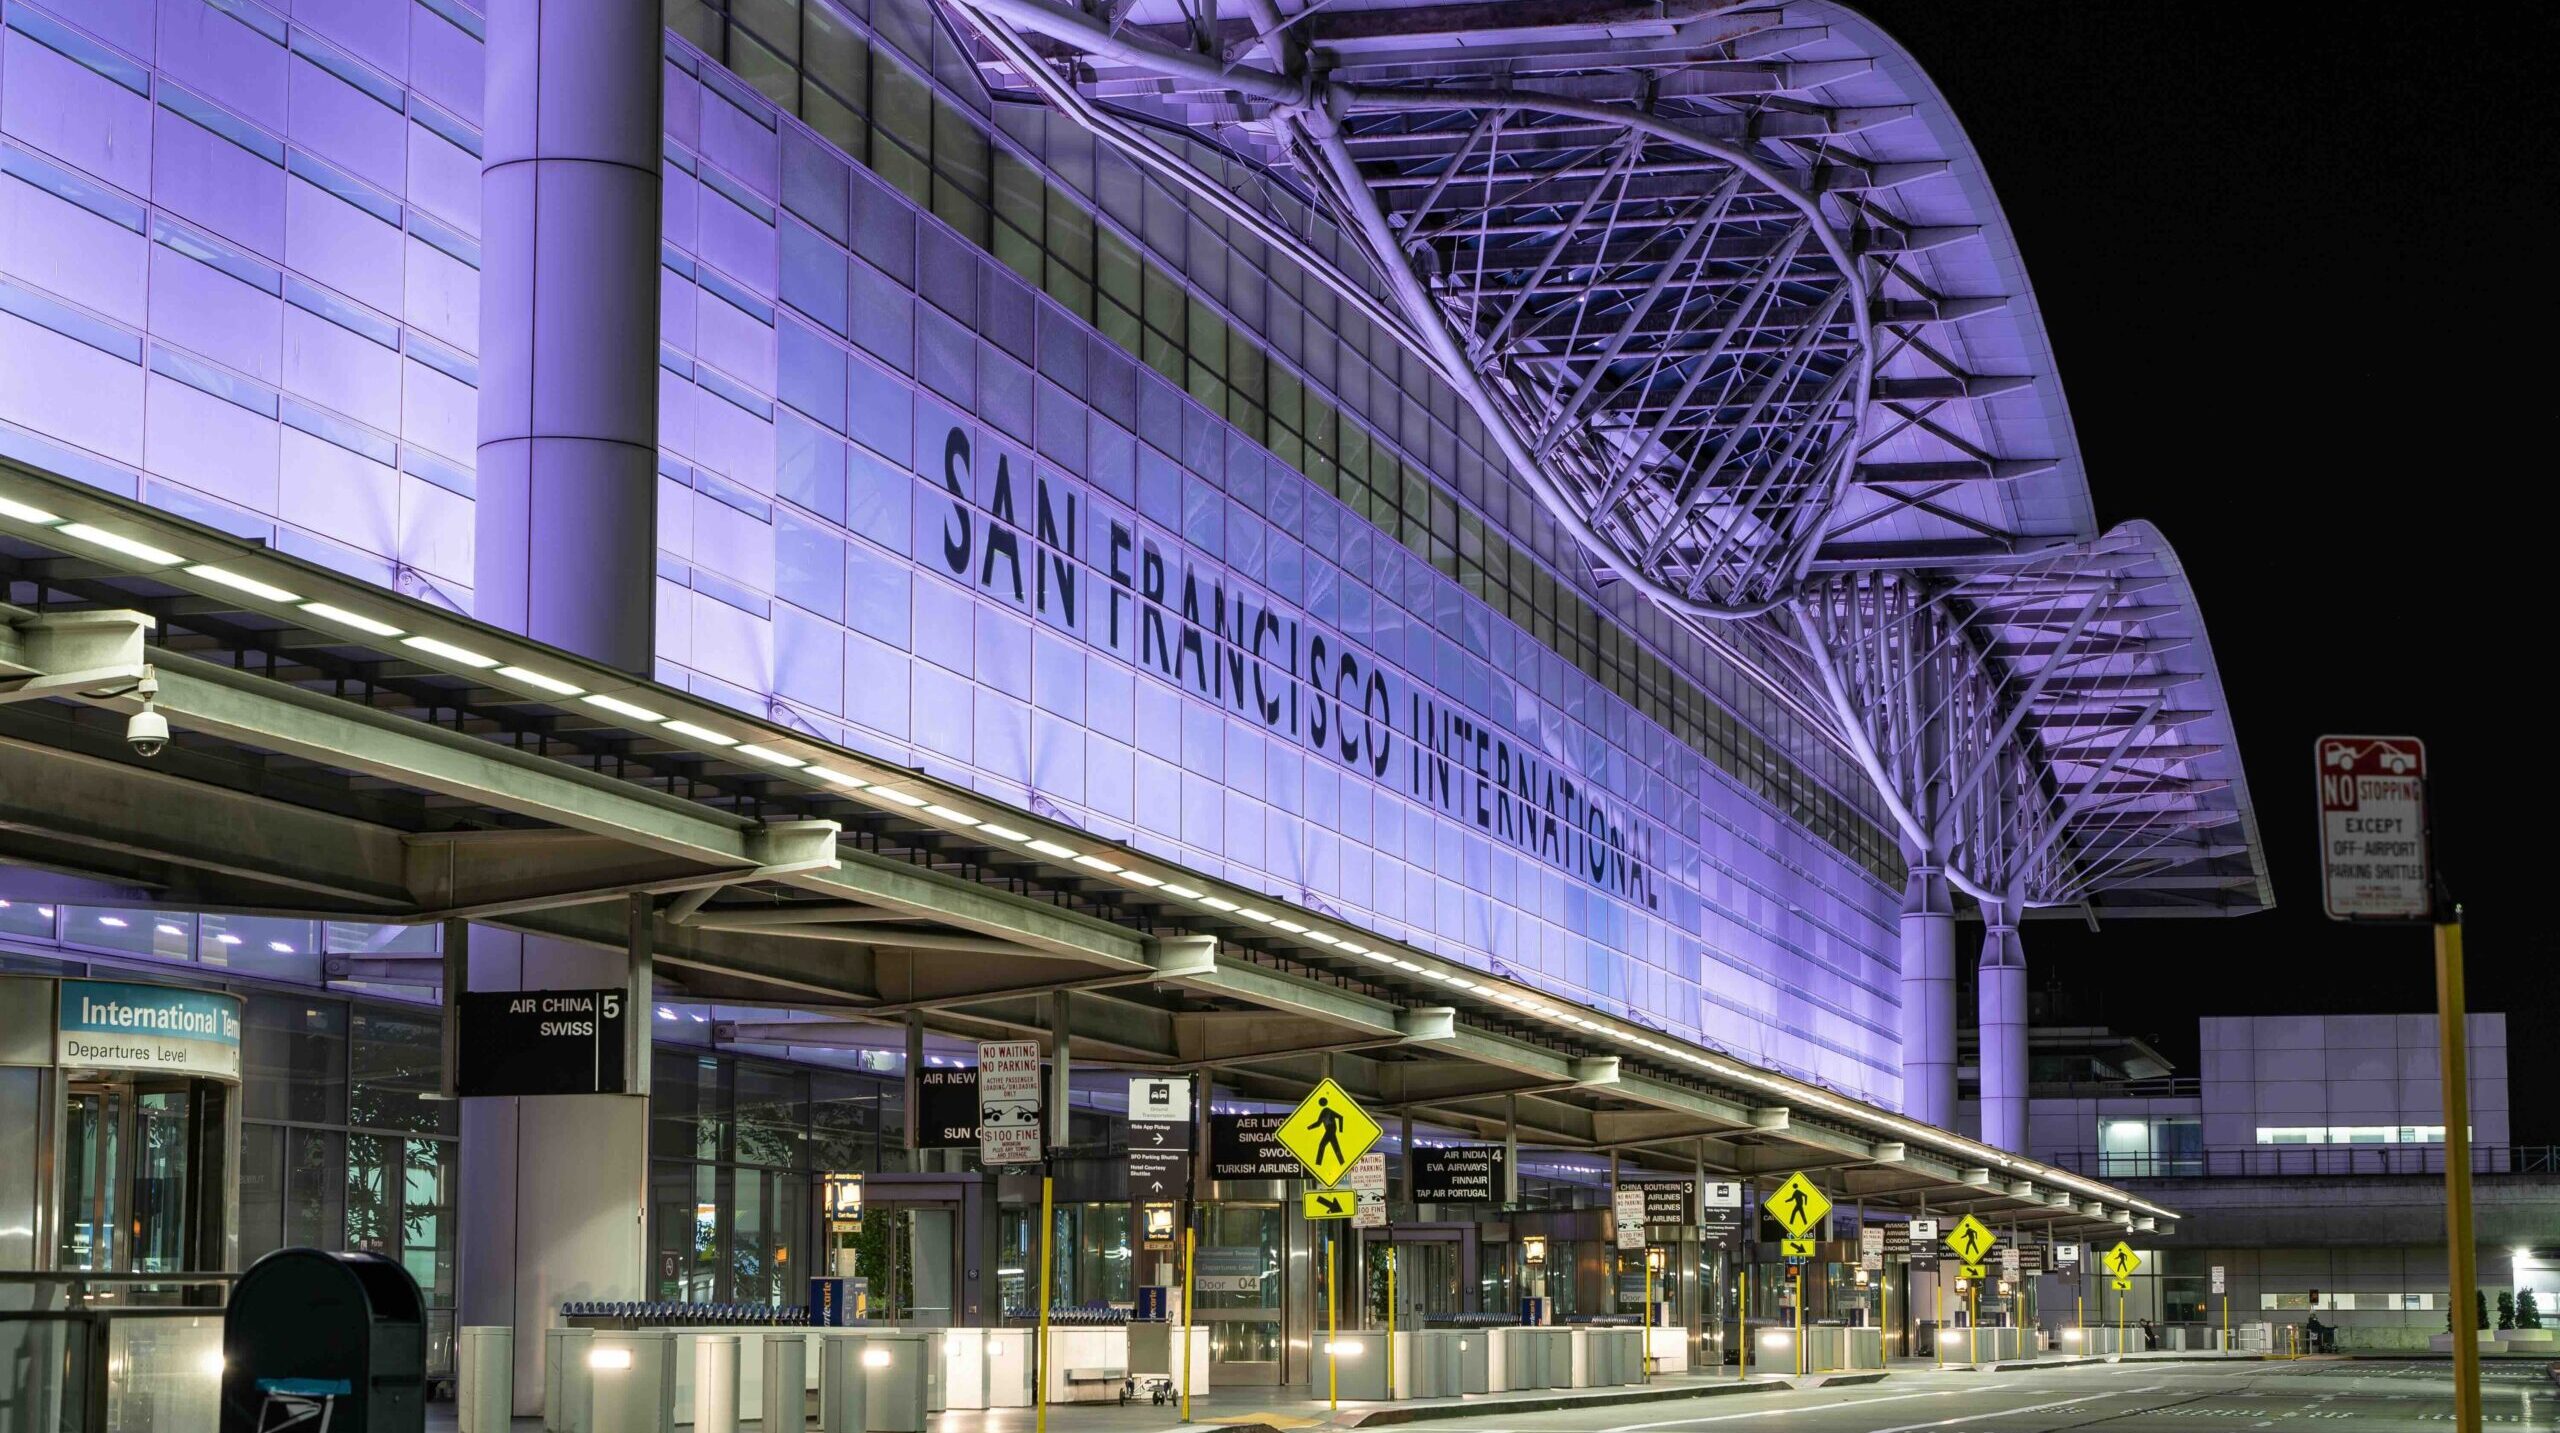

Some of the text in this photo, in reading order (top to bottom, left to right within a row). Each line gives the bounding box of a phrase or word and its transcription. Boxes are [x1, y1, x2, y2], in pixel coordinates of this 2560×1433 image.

[943, 425, 1657, 911] SAN FRANCISCO INTERNATIONAL
[2324, 774, 2421, 807] NO STOPPING
[2345, 818, 2402, 834] EXCEPT
[2329, 863, 2424, 881] PARKING SHUTTLES
[510, 998, 594, 1013] AIR CHINA
[603, 995, 620, 1019] 5
[82, 996, 217, 1035] International
[540, 1022, 594, 1036] SWISS
[68, 1040, 187, 1063] Departures Level
[983, 1045, 1035, 1059] NO WAITING
[982, 1060, 1036, 1073] NO PARKING
[923, 1072, 977, 1085] AIR NEW
[1236, 1118, 1287, 1129] AER LING
[943, 1128, 970, 1140] SUN
[984, 1130, 1012, 1142] $100
[1016, 1130, 1039, 1140] FINE
[1259, 1147, 1293, 1158] SWOO
[1443, 1150, 1487, 1159] AIR INDIA
[1491, 1150, 1503, 1163] 4
[1216, 1163, 1299, 1174] TURKISH AIRLINES
[1360, 1164, 1383, 1173] PARKING
[1426, 1162, 1488, 1172] EVA AIRWAYS
[1451, 1176, 1488, 1185] FINNAIR
[1620, 1183, 1681, 1191] CHINA SOUTHERN
[1684, 1182, 1694, 1194] 3
[1416, 1189, 1488, 1198] TAP AIR PORTUGAL
[1647, 1193, 1681, 1201] AIRLINES
[1358, 1205, 1385, 1214] 100 FINE
[1198, 1277, 1257, 1290] Door 04
